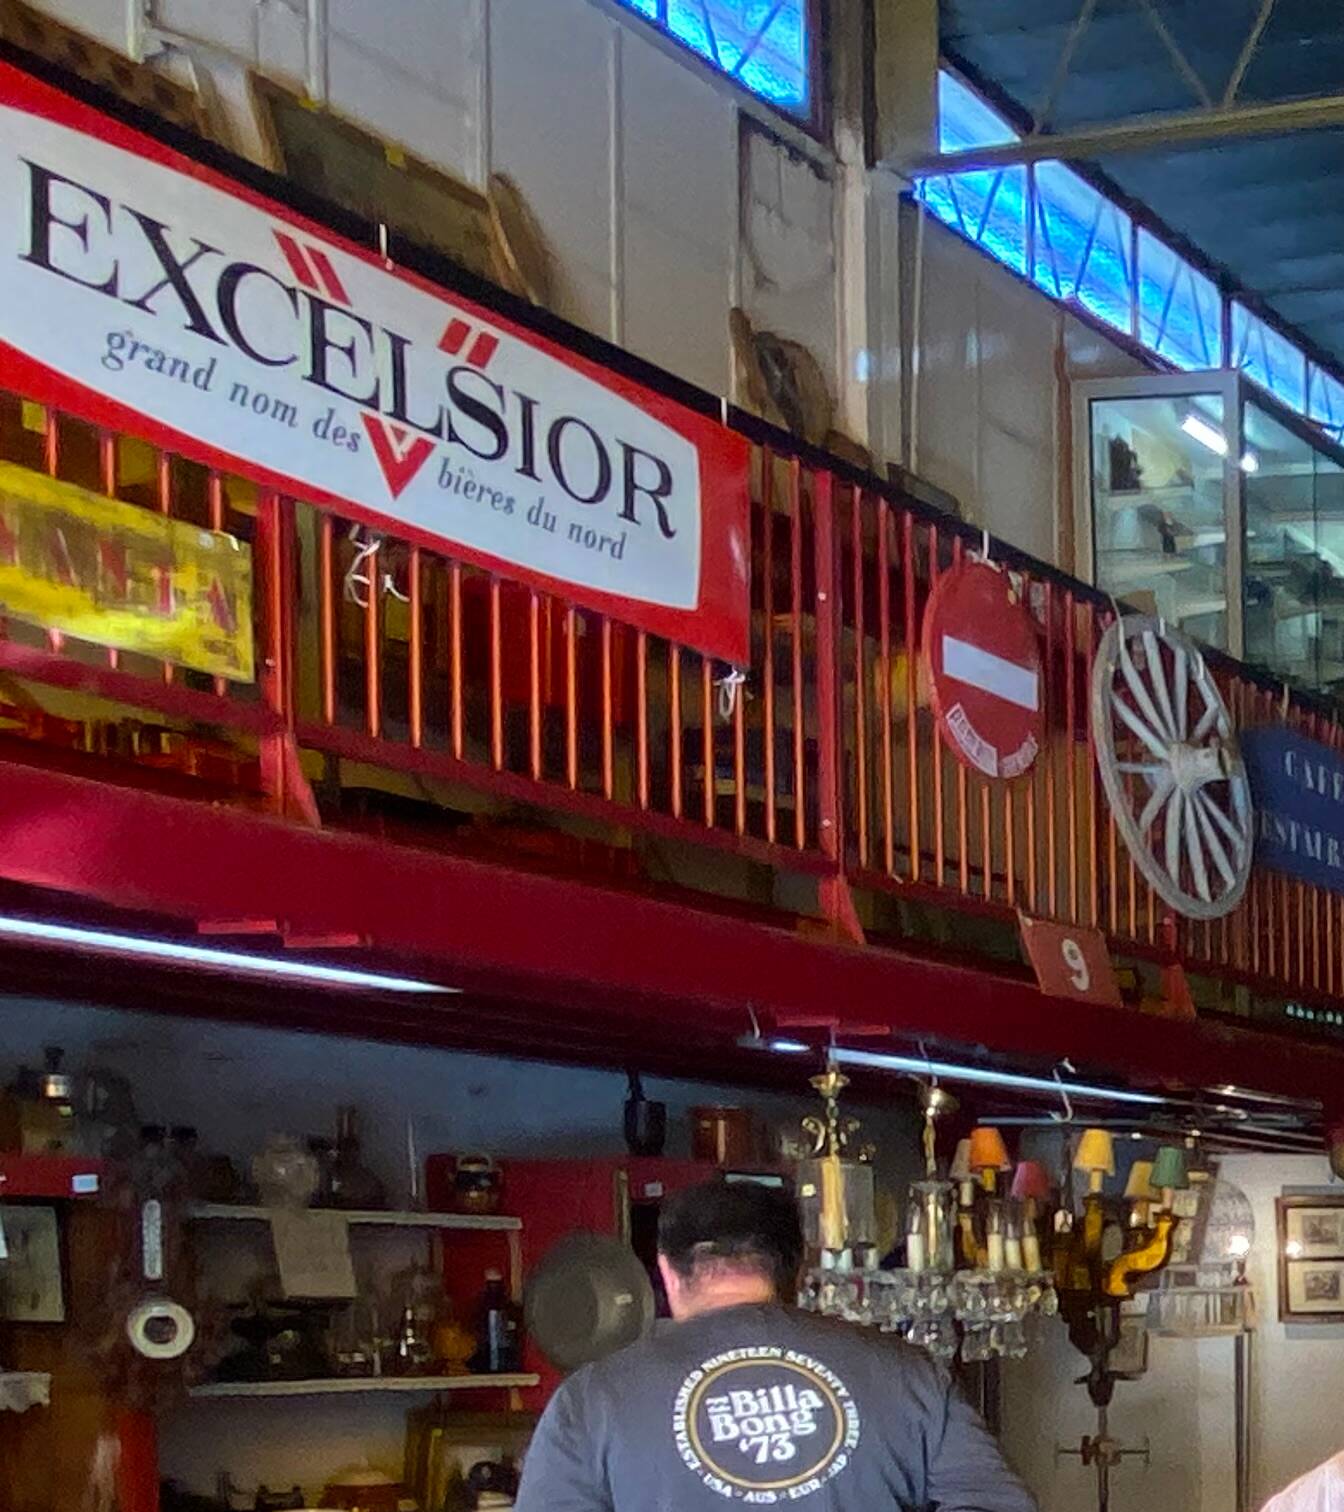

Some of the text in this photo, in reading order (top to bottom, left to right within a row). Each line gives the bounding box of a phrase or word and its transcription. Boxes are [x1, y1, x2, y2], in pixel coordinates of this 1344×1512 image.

[17, 155, 677, 539] EXCELSIOR
[100, 331, 627, 561] grand nom des bières du nord
[1062, 938, 1090, 991] 9
[673, 1347, 860, 1470] ESTABLISHED NINETEEN SEVENTY THREE
[708, 1407, 817, 1441] Bong
[729, 1384, 824, 1418] Billa
[703, 1473, 733, 1497] USA
[743, 1491, 777, 1504] AUS
[788, 1478, 821, 1500] EUR
